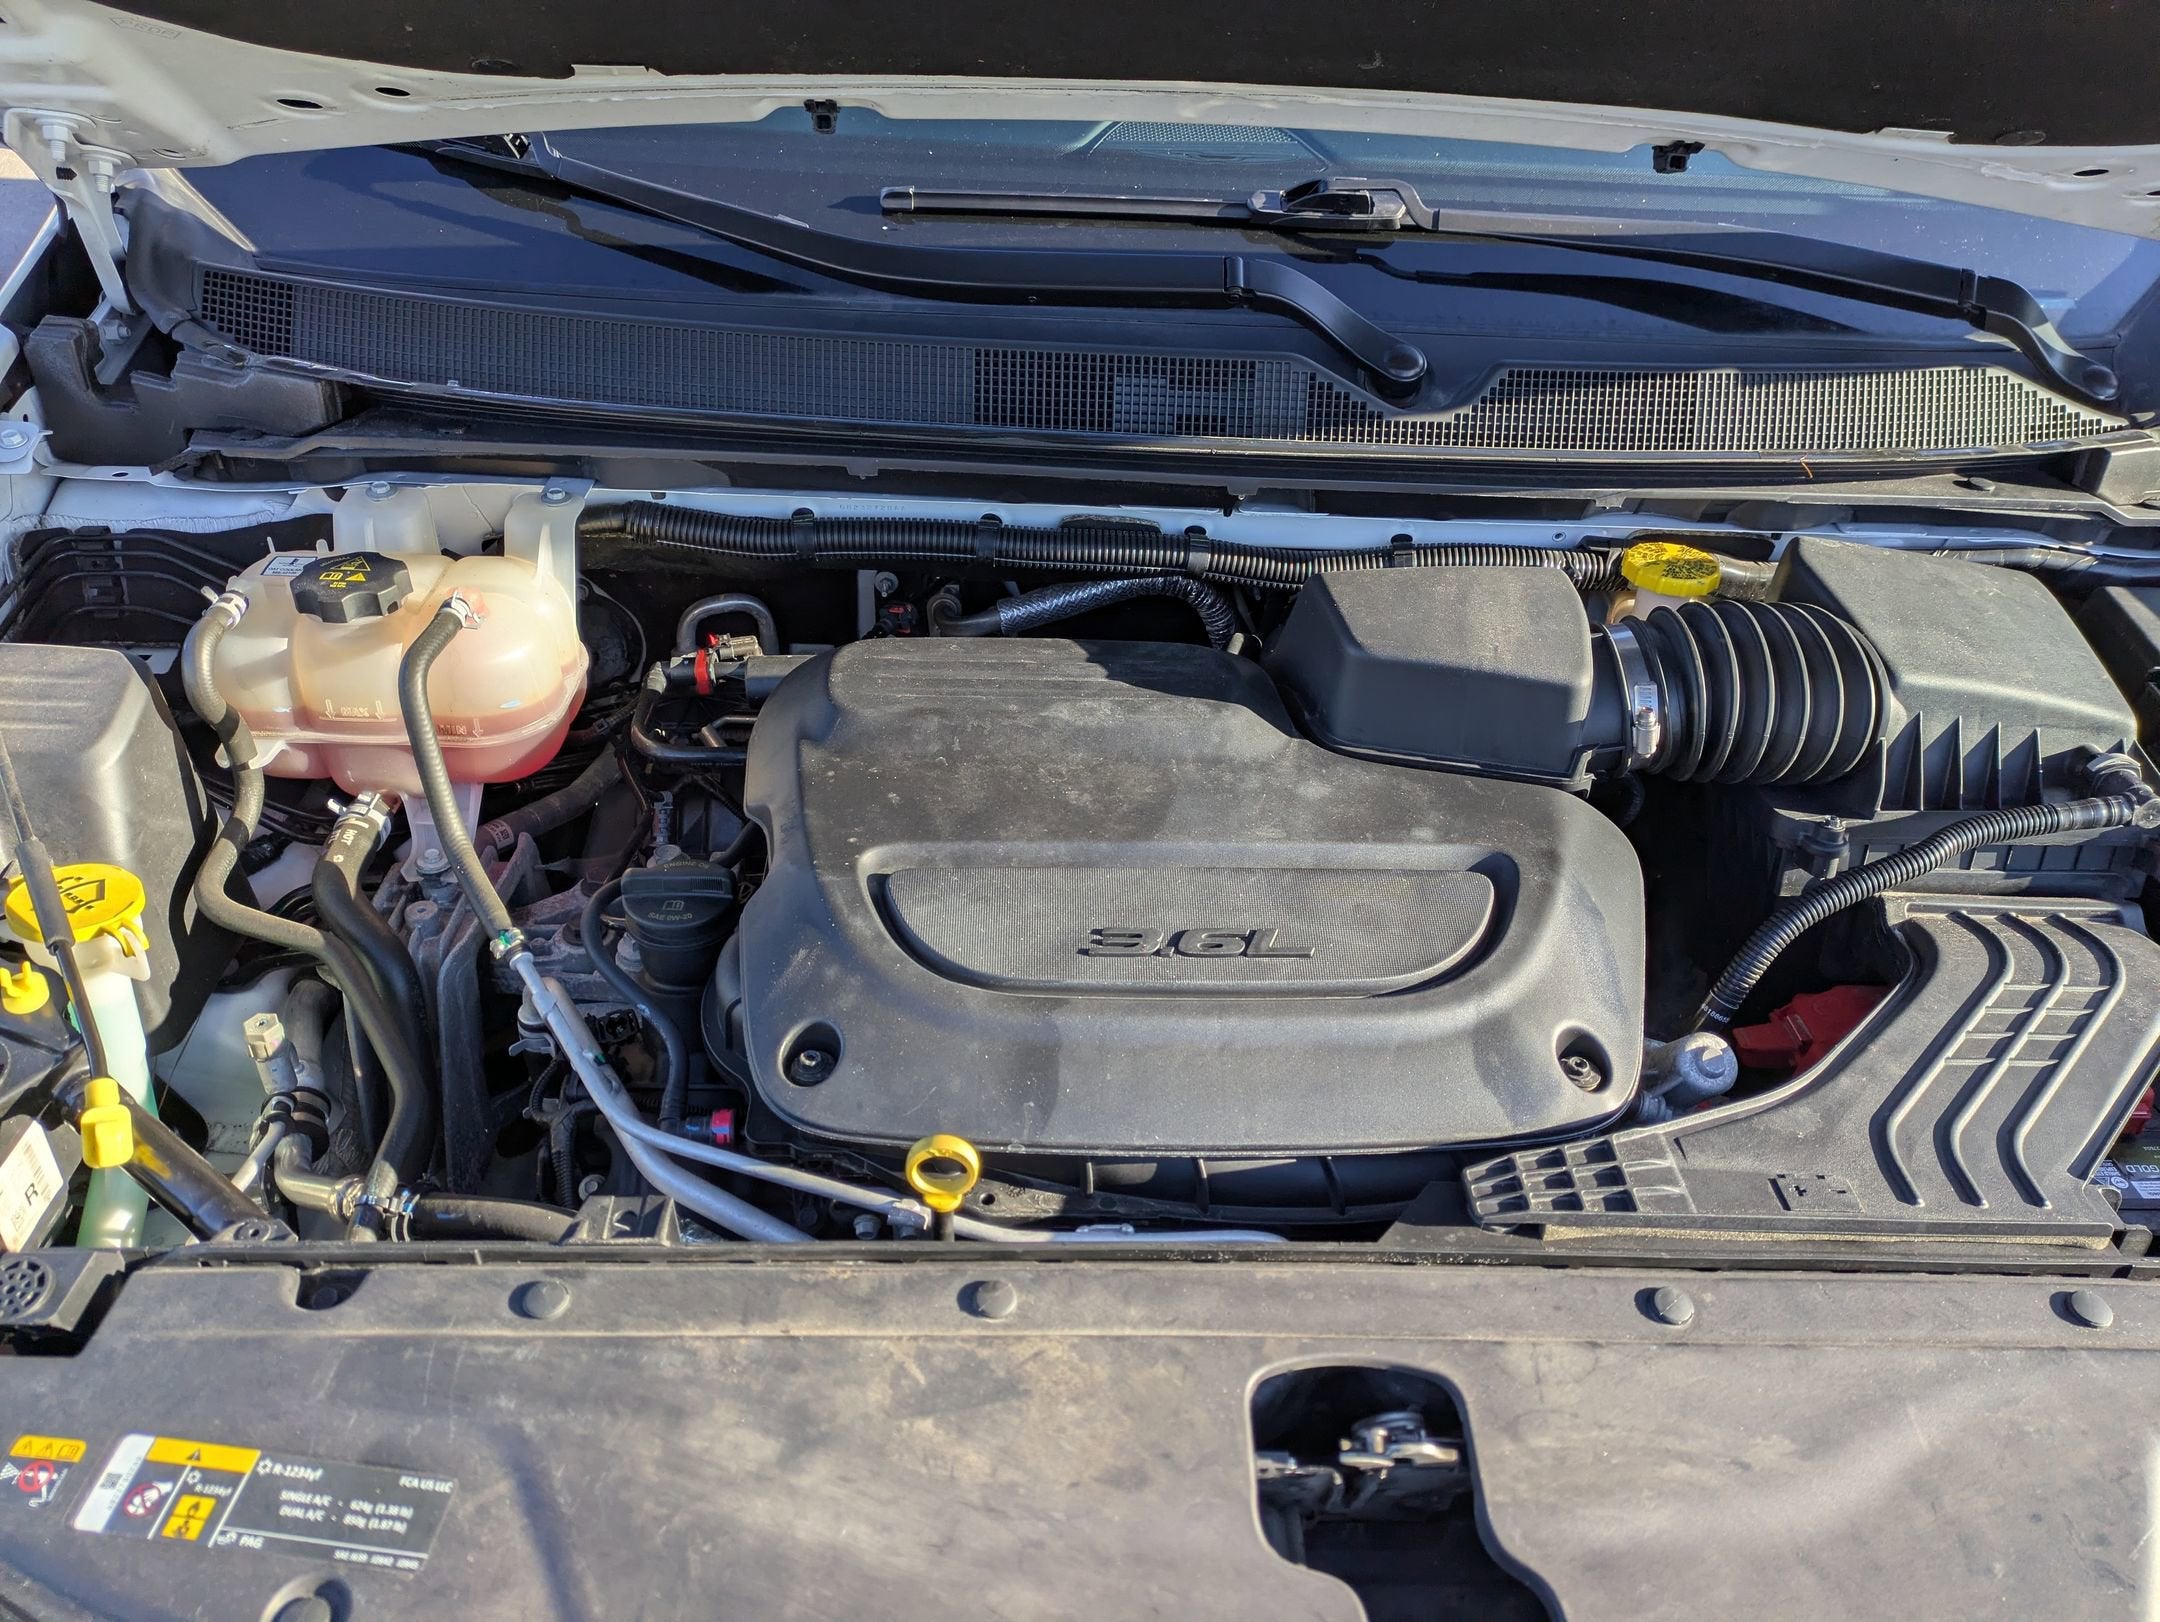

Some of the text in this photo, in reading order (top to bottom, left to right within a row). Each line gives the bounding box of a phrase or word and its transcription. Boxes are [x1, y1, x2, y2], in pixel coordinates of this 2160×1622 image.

[340, 706, 370, 717] MAX
[341, 828, 358, 846] HOT
[663, 861, 697, 869] ENGINE
[1086, 926, 1316, 958] 3.6L
[2125, 1164, 2160, 1173] GOLD
[25, 1183, 38, 1206] R
[272, 1463, 454, 1494] R-1234yf FCA US LLC
[279, 1489, 312, 1504] SINGLE
[312, 1494, 333, 1508] A/C
[279, 1505, 306, 1519] DUAL
[306, 1509, 326, 1522] A/C
[238, 1534, 264, 1550] PAG
